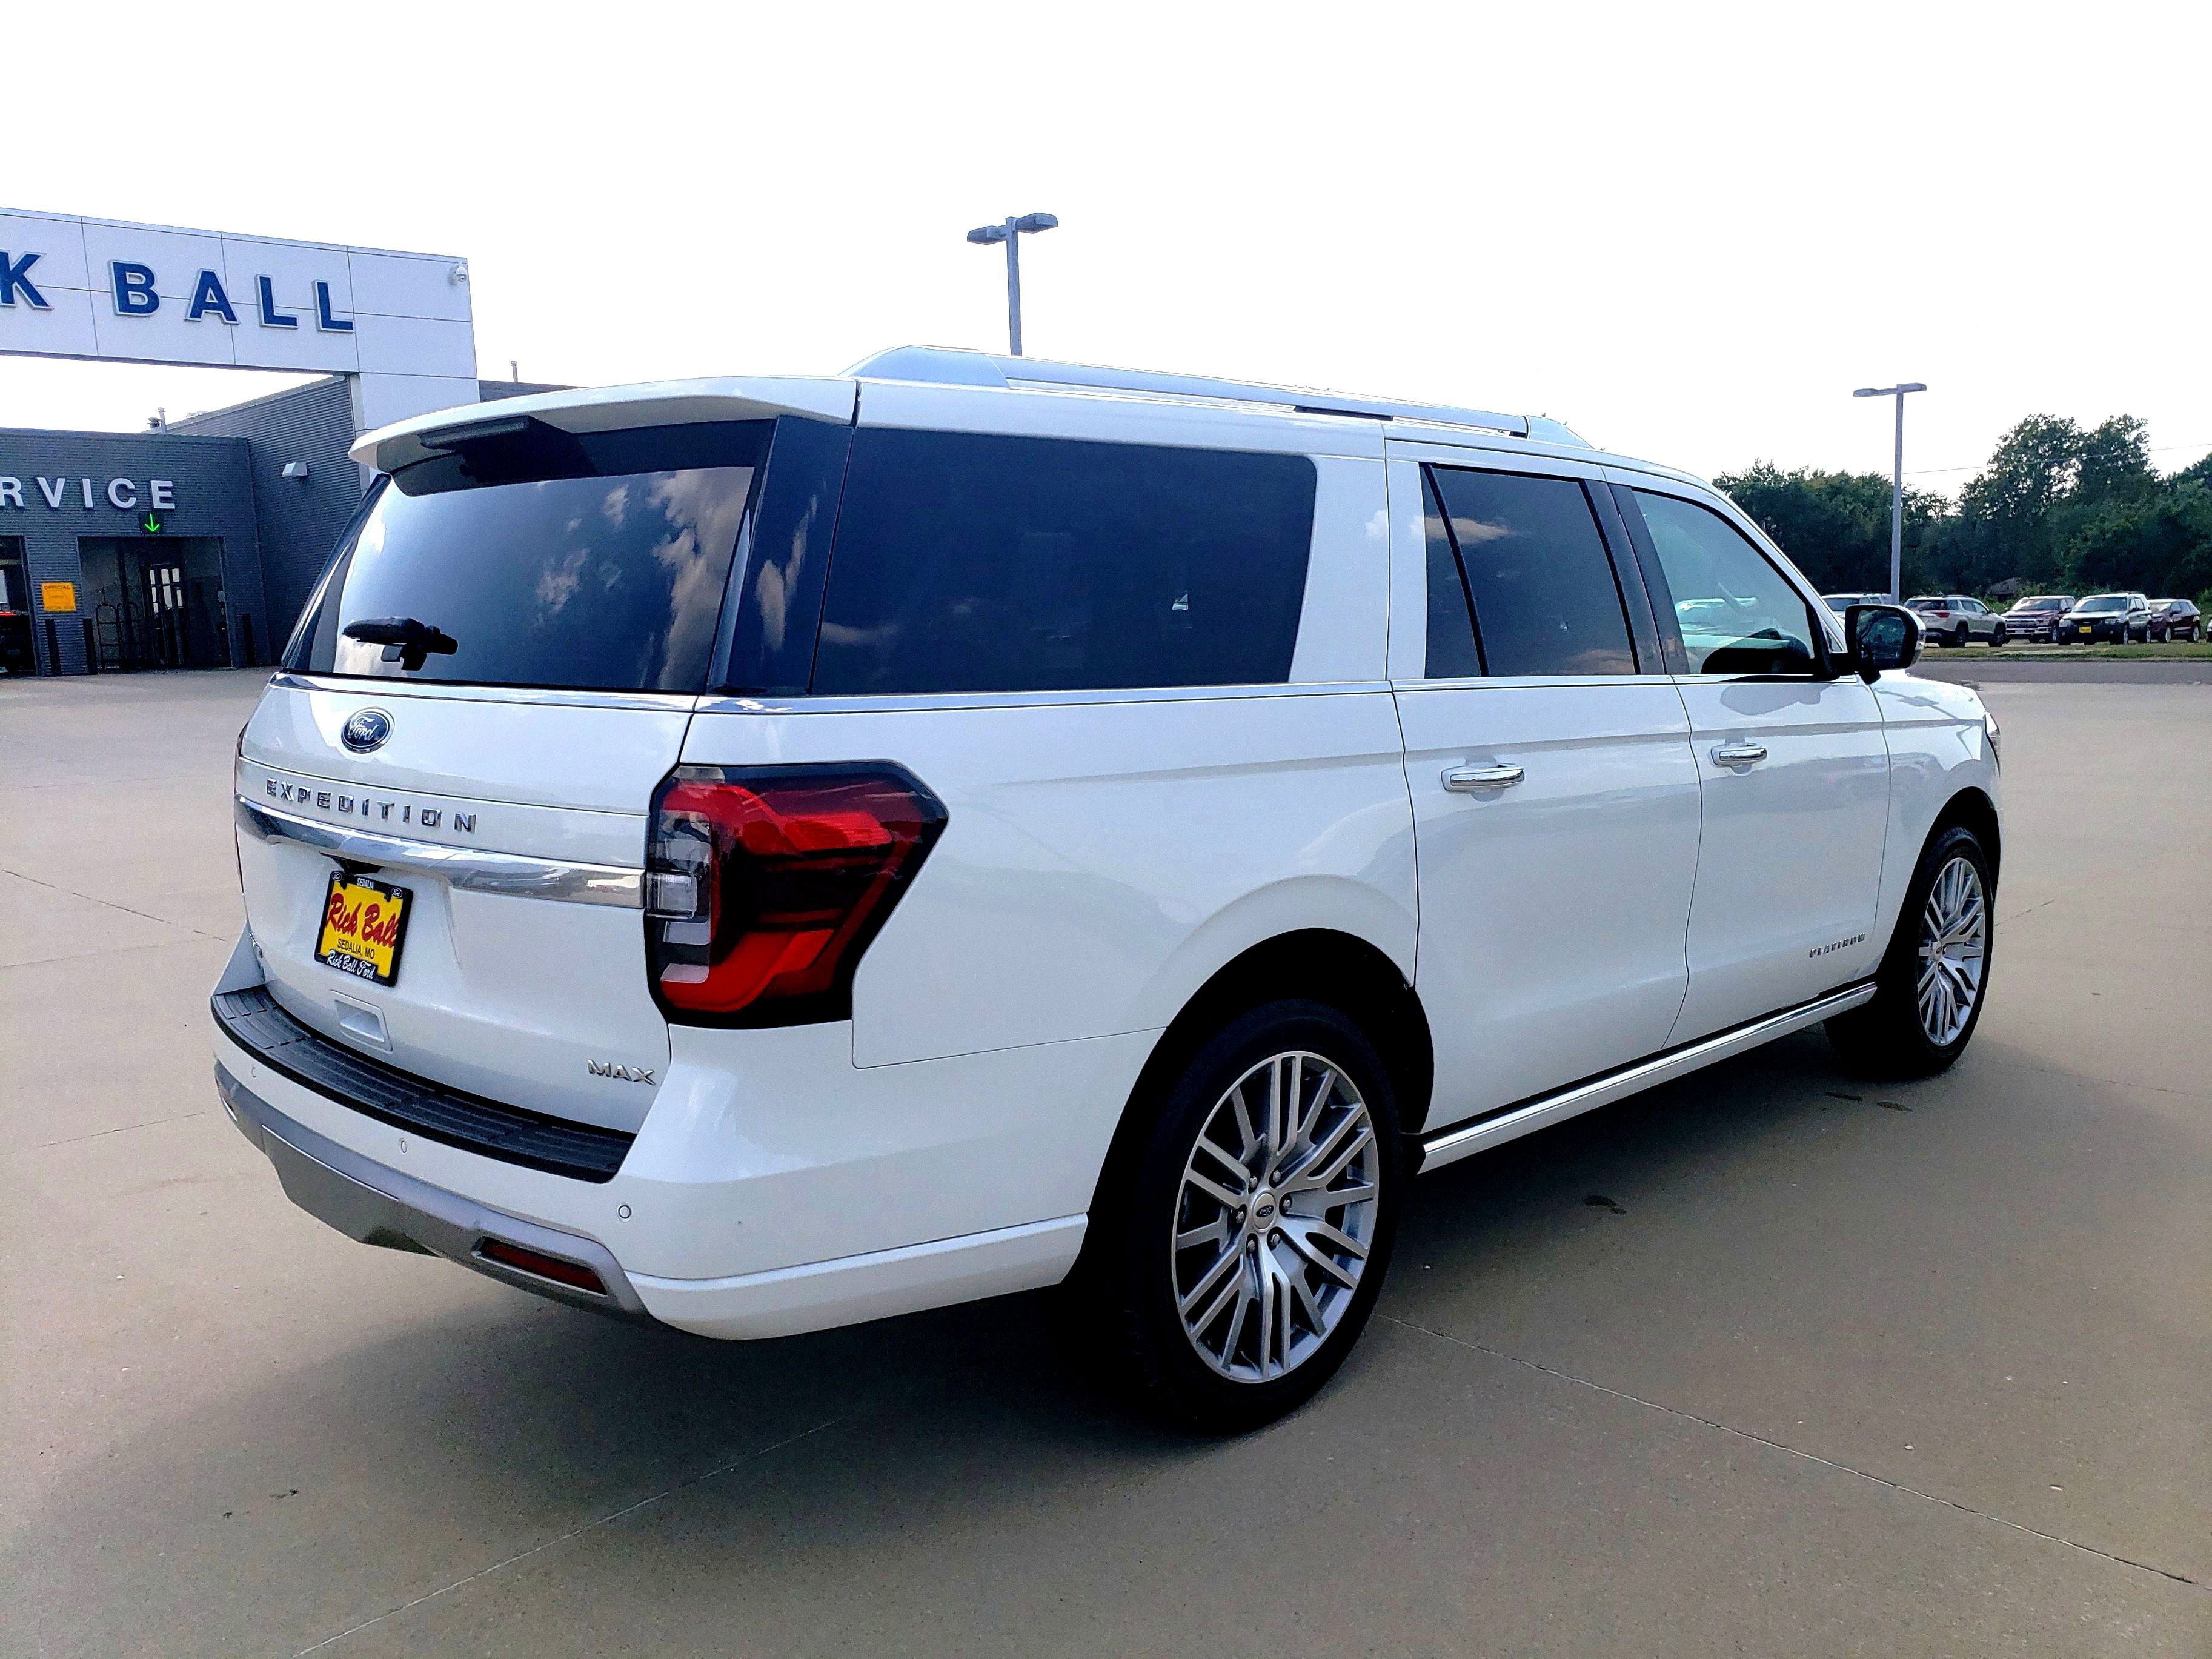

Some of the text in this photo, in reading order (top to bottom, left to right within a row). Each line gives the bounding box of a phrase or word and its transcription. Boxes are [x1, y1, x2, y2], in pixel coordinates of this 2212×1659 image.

[0, 249, 355, 333] K BALL
[0, 476, 176, 509] RVICE
[348, 716, 380, 741] Ford
[266, 777, 477, 834] EXPEDITION
[325, 893, 399, 948] Rick Ball
[326, 949, 376, 980] Rick Ball Ford
[364, 946, 376, 960] MO
[586, 1059, 656, 1086] MAX
